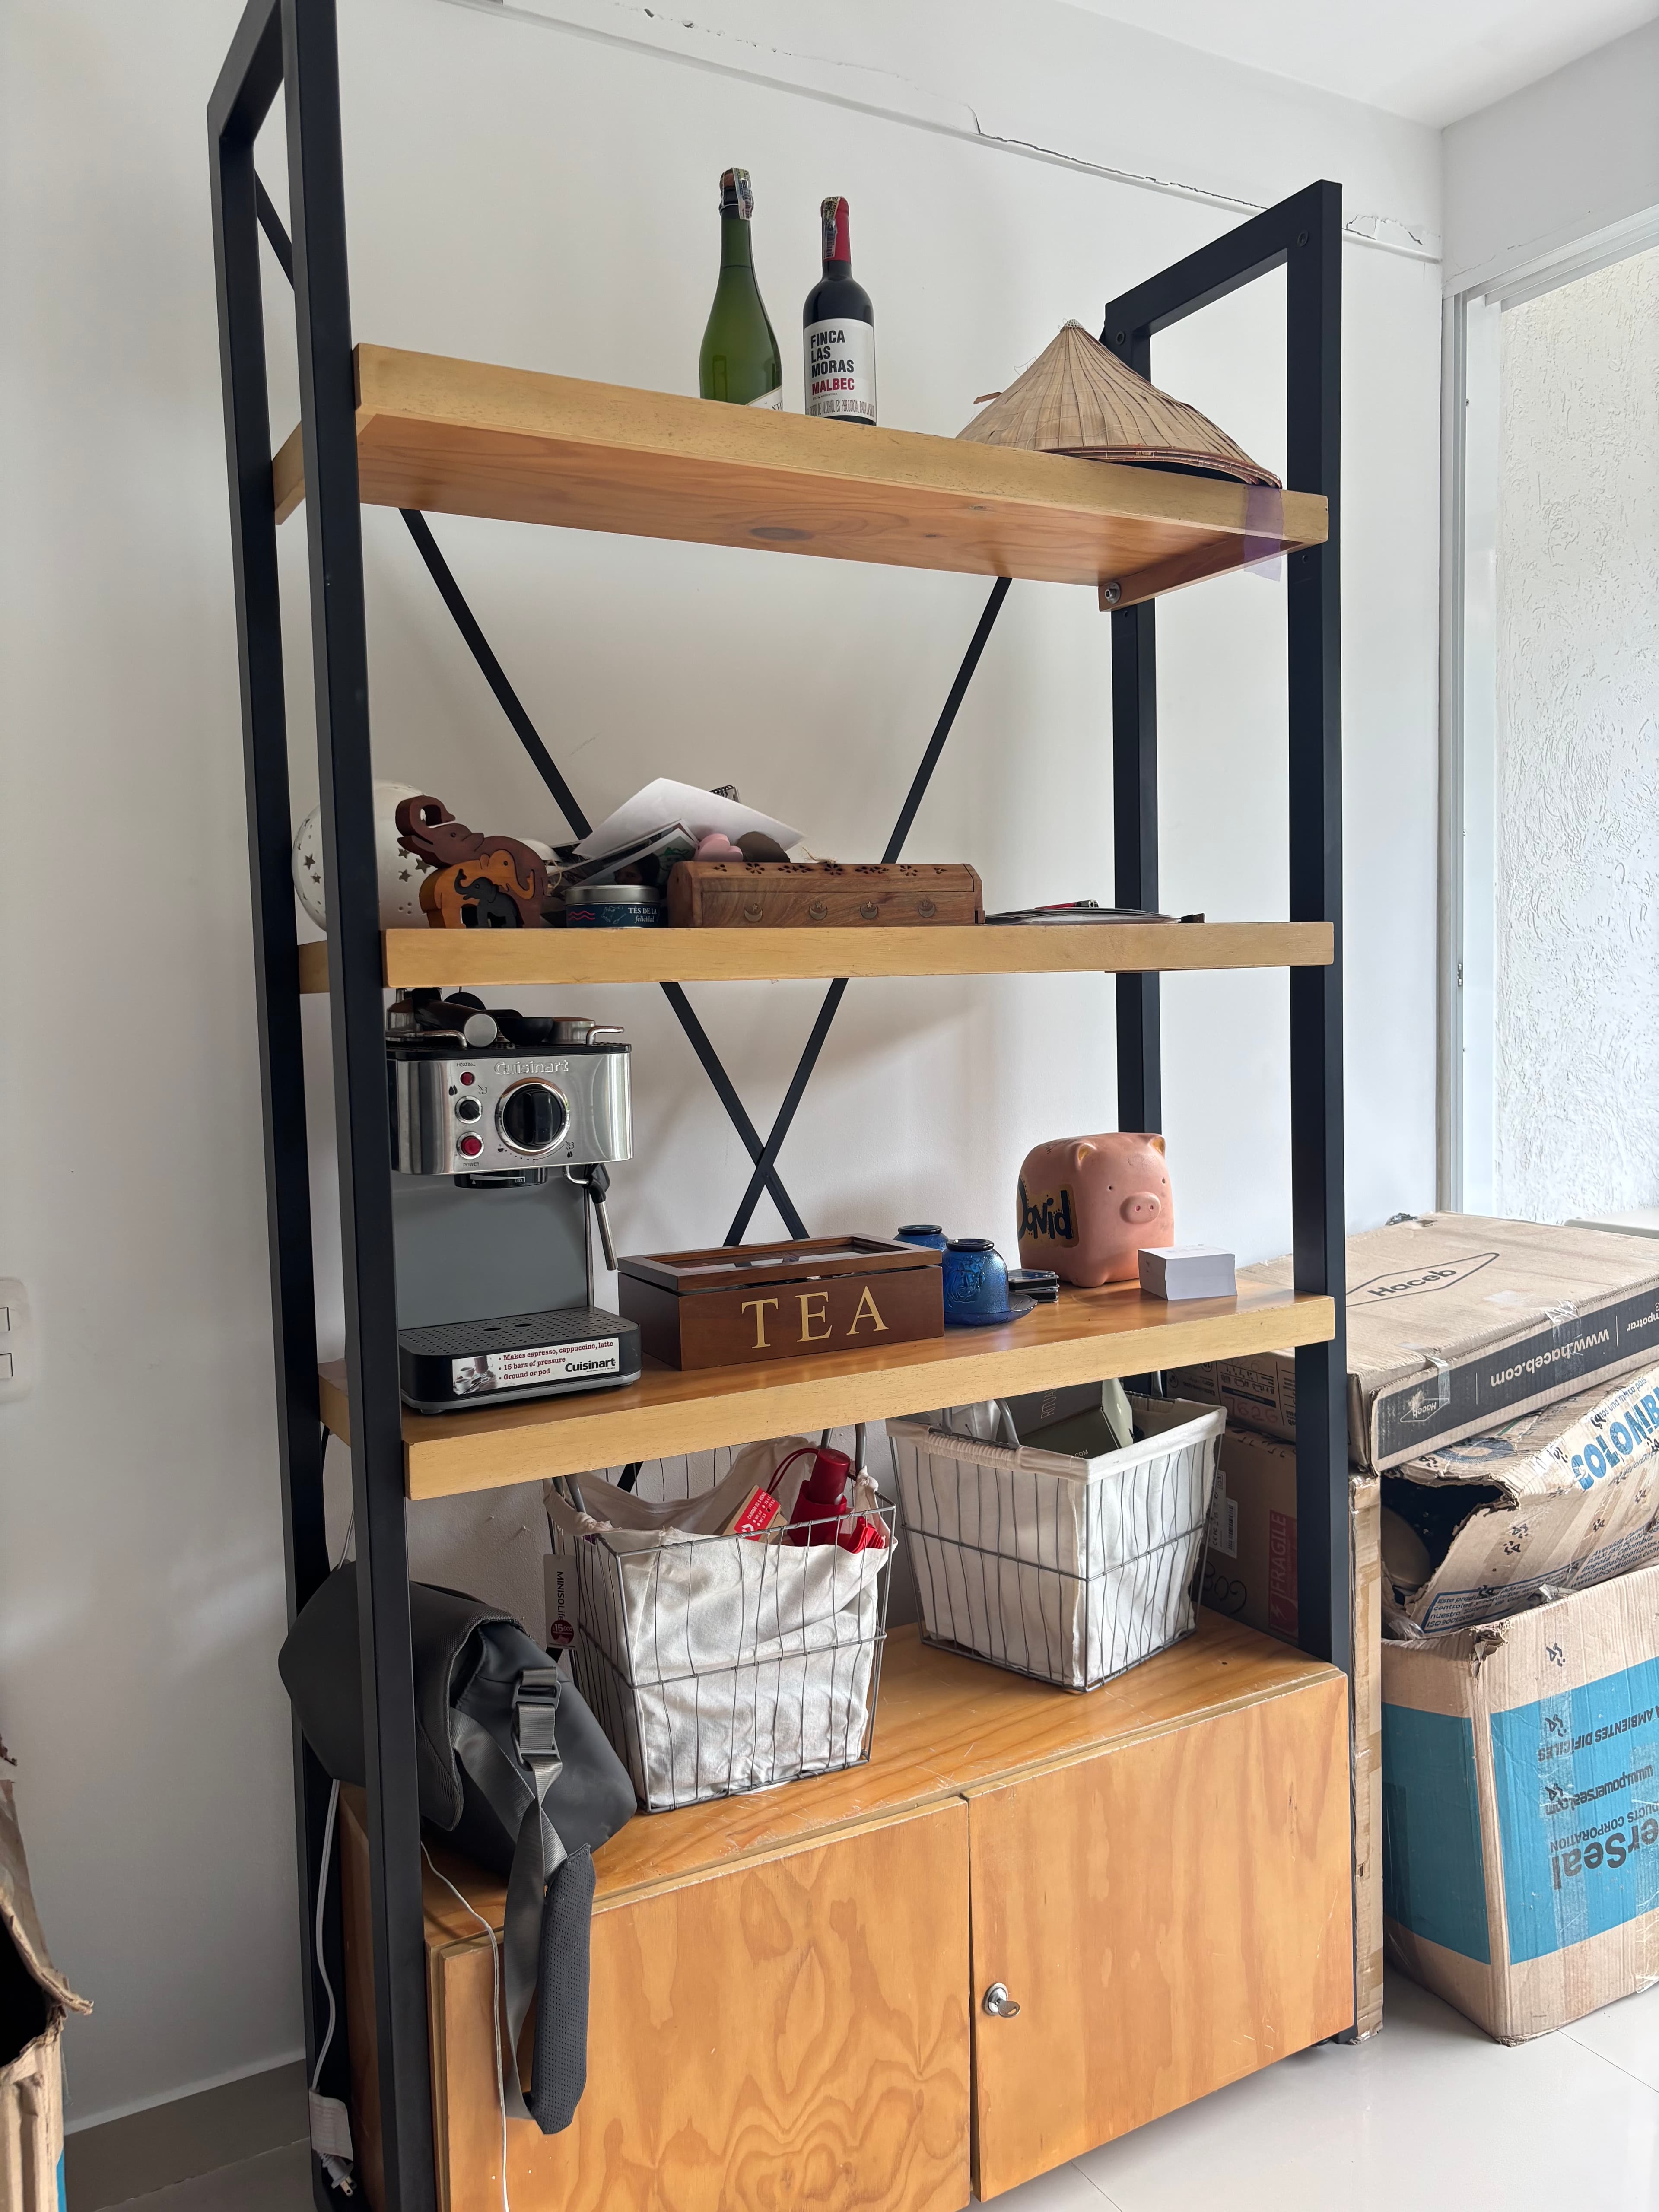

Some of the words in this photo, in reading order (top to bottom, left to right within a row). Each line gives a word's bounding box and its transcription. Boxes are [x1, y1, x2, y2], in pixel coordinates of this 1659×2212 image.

[810, 330, 845, 349] FINCA
[811, 346, 831, 363] LAS
[811, 360, 855, 378] MORAS
[812, 378, 855, 395] MALBEC
[823, 400, 835, 413] ALCOHOL
[836, 400, 840, 412] ES
[634, 915, 654, 924] felicidad
[494, 1059, 569, 1075] Cuisinart
[1367, 1270, 1456, 1297] Haceb
[741, 1285, 890, 1349] TEA
[503, 1353, 526, 1361] Makes
[527, 1349, 558, 1358] espresso,
[559, 1343, 598, 1355] cappuccino,
[1490, 1329, 1610, 1387] www.haceb.com
[537, 1357, 566, 1367] pressure
[565, 1357, 616, 1373] Cuisinart
[504, 1372, 528, 1380] Ground
[538, 1368, 551, 1376] pod
[1413, 1402, 1437, 1419] Haceb
[1608, 1398, 1619, 1412] una
[1571, 1386, 1659, 1490] COLOMB
[1271, 1513, 1286, 1596] FRAGILE
[1595, 1707, 1654, 1743] AMBIENTES
[1550, 1815, 1624, 1853] CORPORATION
[1551, 1818, 1659, 1890] erSeal
